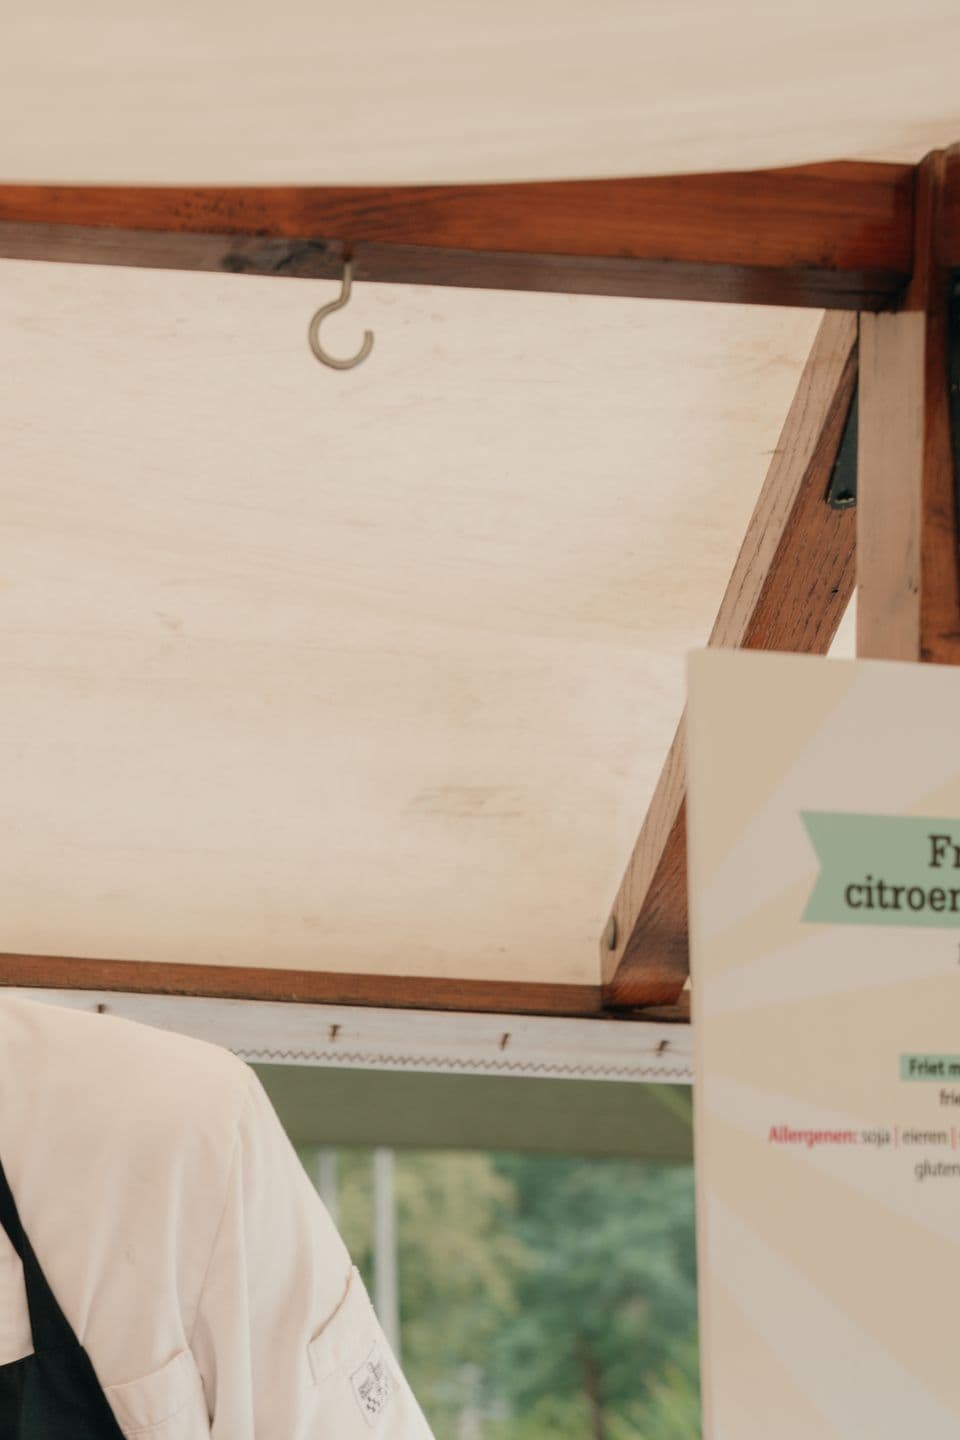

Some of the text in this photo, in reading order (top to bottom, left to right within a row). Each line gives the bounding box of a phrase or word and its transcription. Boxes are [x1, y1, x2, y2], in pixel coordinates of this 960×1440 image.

[909, 1058, 944, 1076] Friet
[769, 1125, 947, 1148] Allergenen: soja eieren
